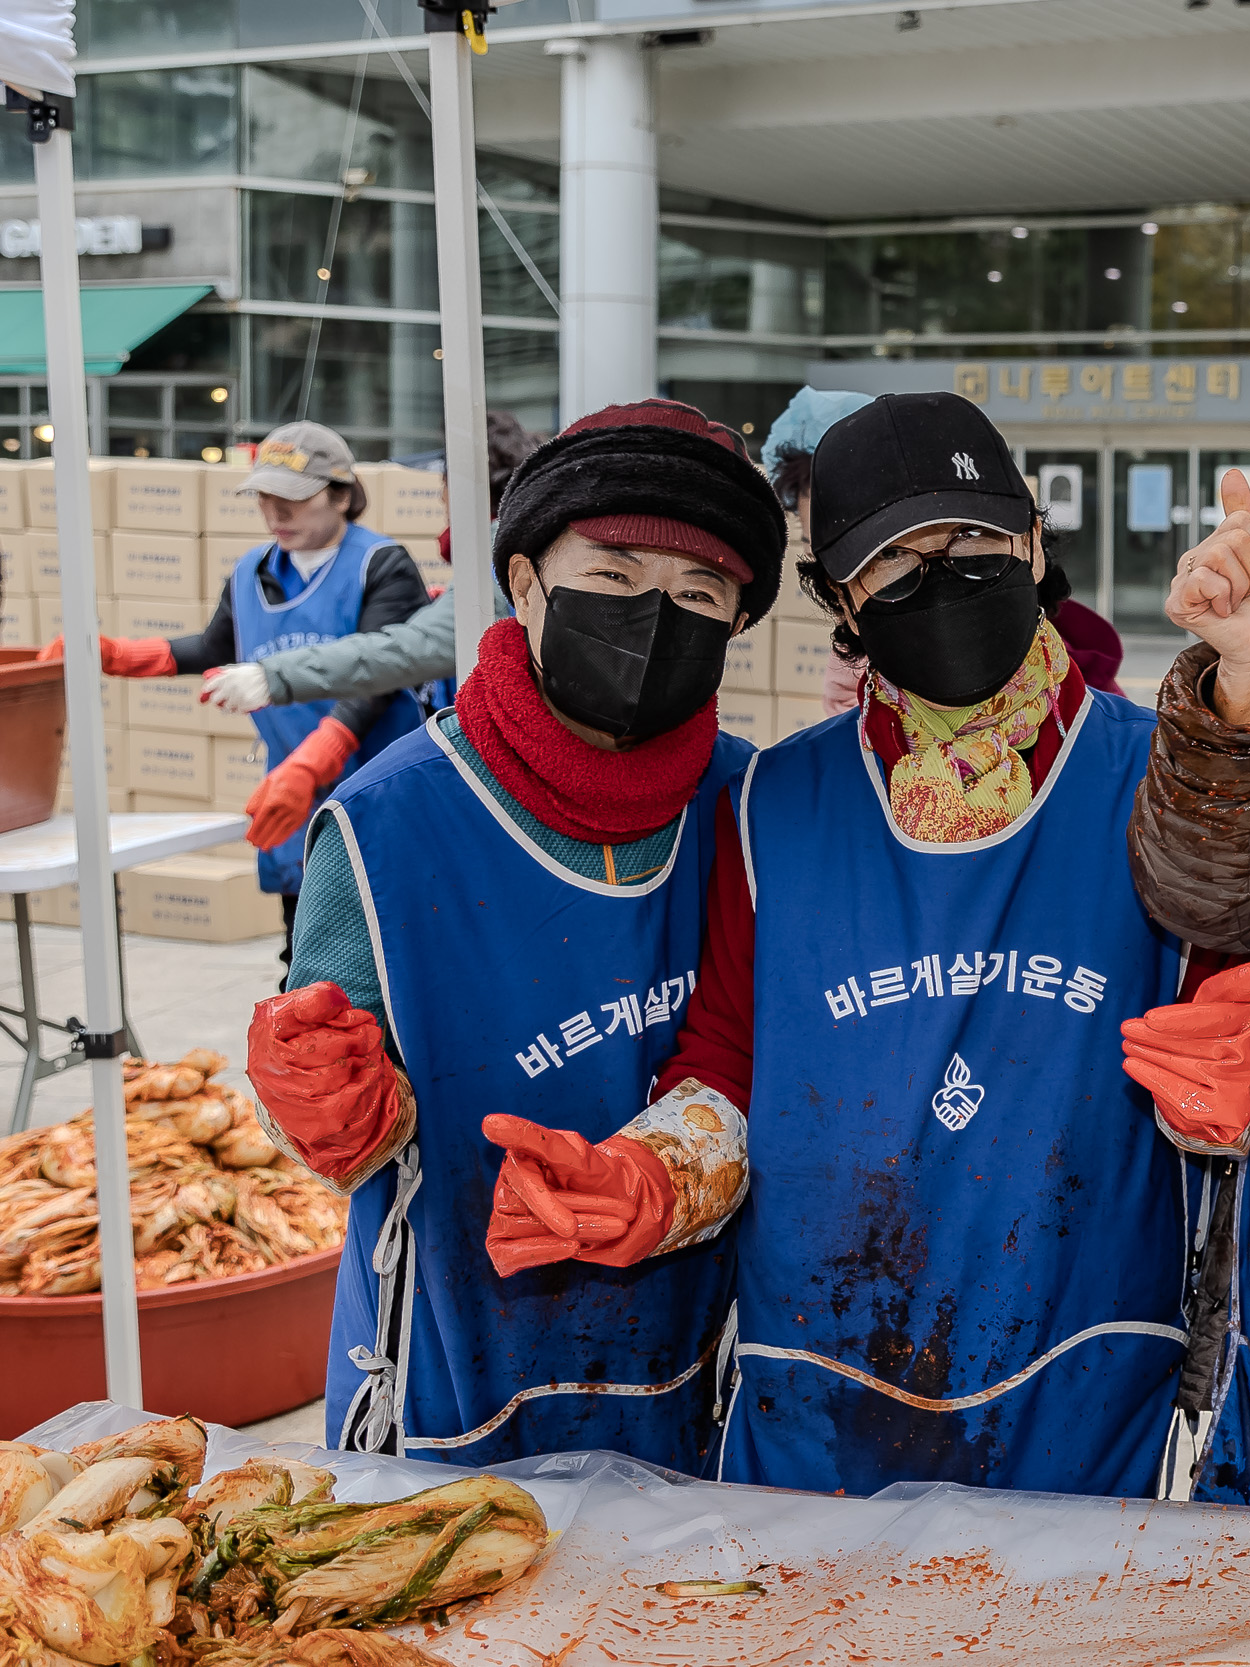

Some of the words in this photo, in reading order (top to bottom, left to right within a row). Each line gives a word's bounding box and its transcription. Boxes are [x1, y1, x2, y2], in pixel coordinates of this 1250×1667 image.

[951, 452, 980, 480] NY
[824, 950, 1108, 1020] 바르게살기운동
[515, 970, 697, 1079] 바르게살기
